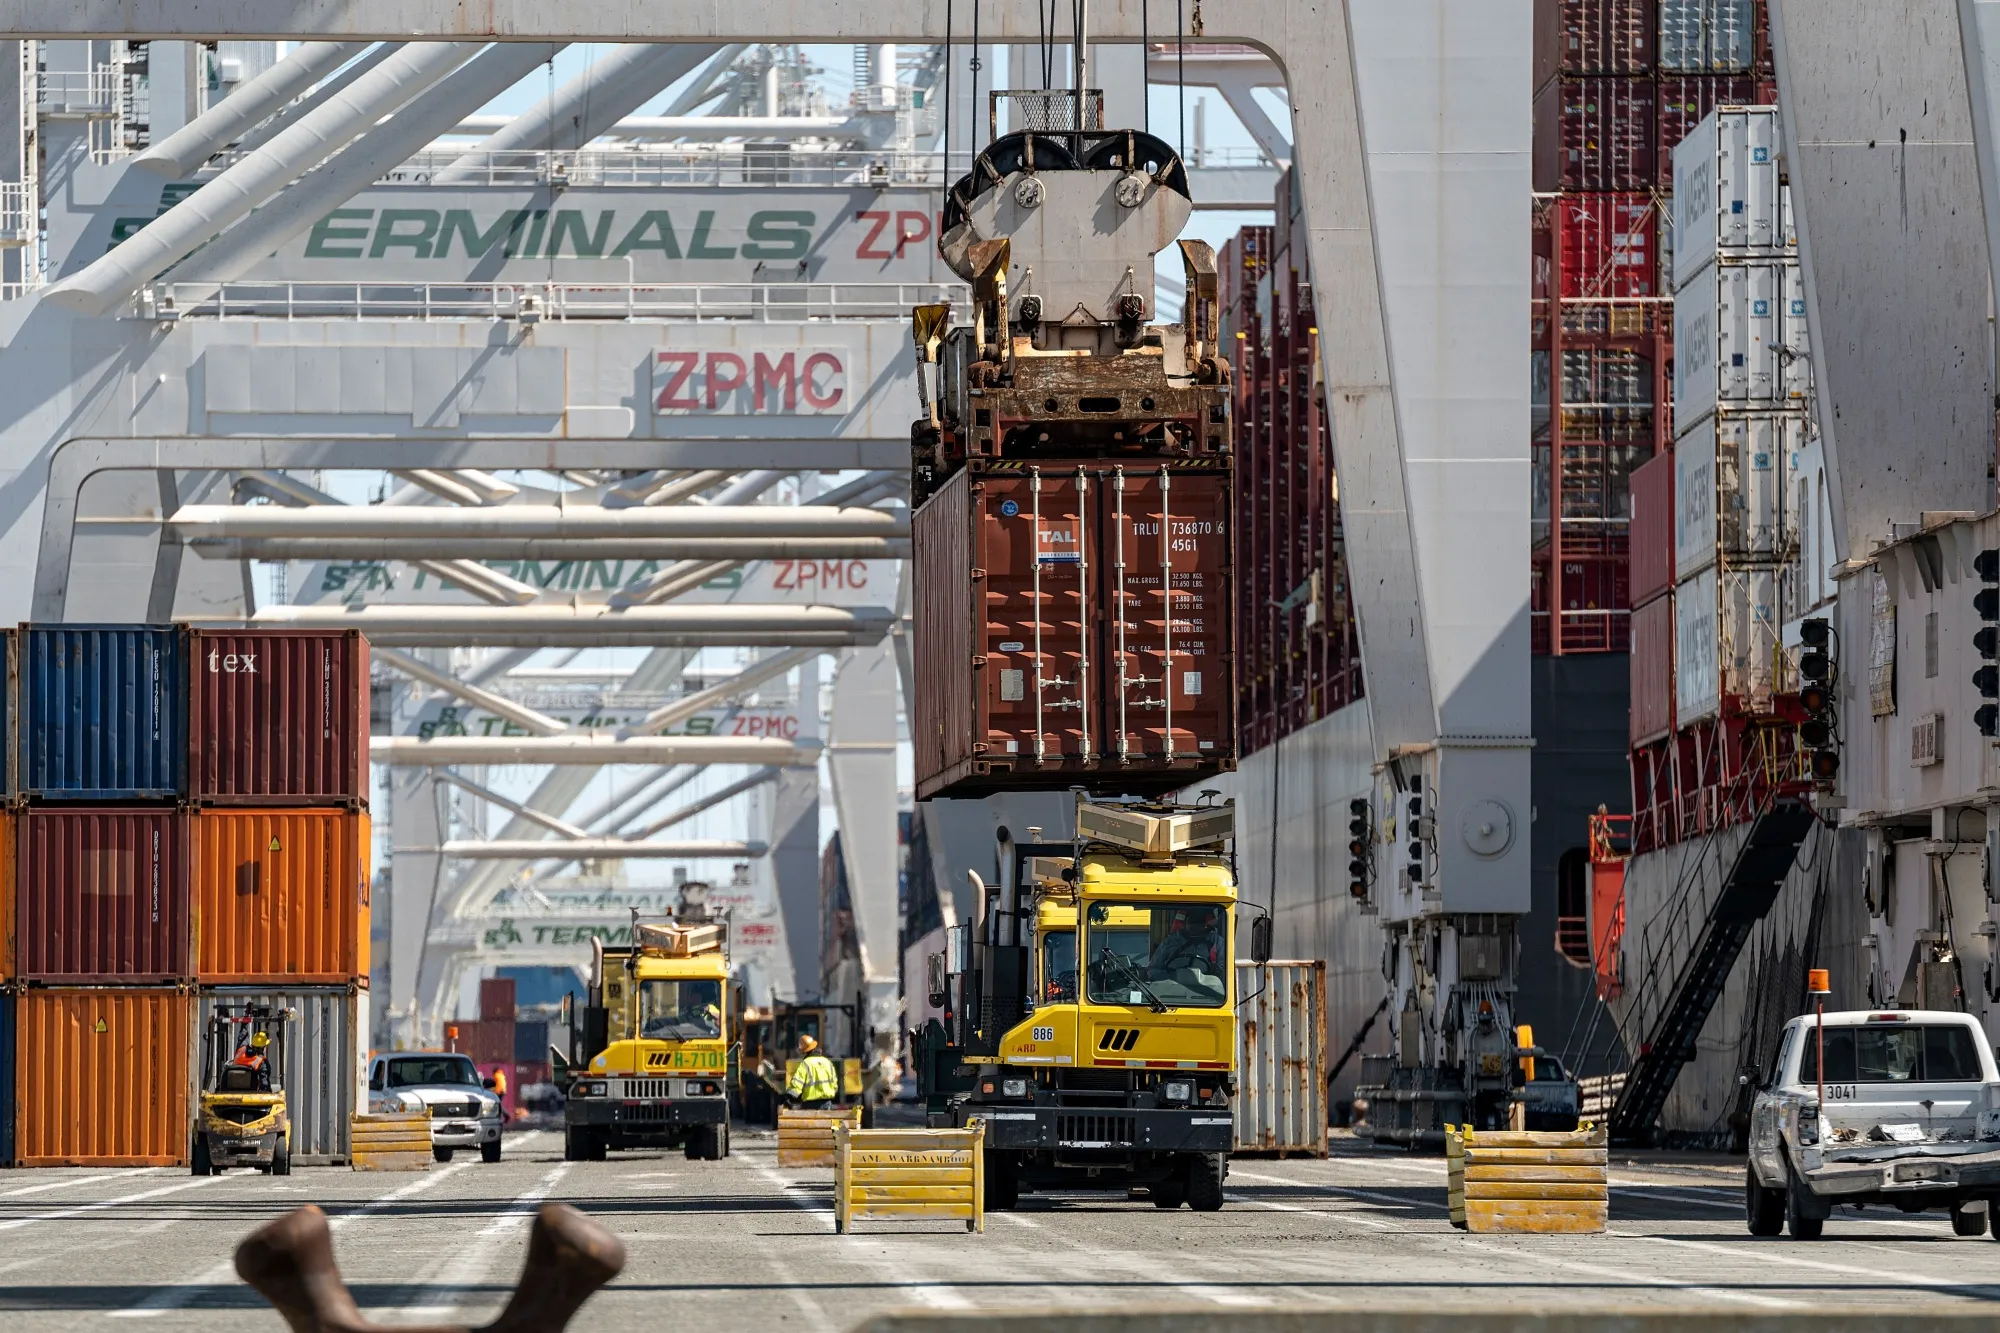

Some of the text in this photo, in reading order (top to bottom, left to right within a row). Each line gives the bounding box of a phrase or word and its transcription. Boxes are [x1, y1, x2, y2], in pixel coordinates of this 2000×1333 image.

[268, 208, 816, 261] ERMINALS
[657, 352, 844, 410] ZPMC
[1038, 530, 1077, 543] TAL
[1133, 521, 1224, 536] TRLU 736870 6
[1171, 539, 1197, 552] 45G1
[772, 560, 868, 589] ZPMC
[207, 648, 258, 673] tex
[732, 715, 799, 737] ZPMC
[1033, 1027, 1053, 1040] 886
[1827, 1084, 1857, 1099] 3041
